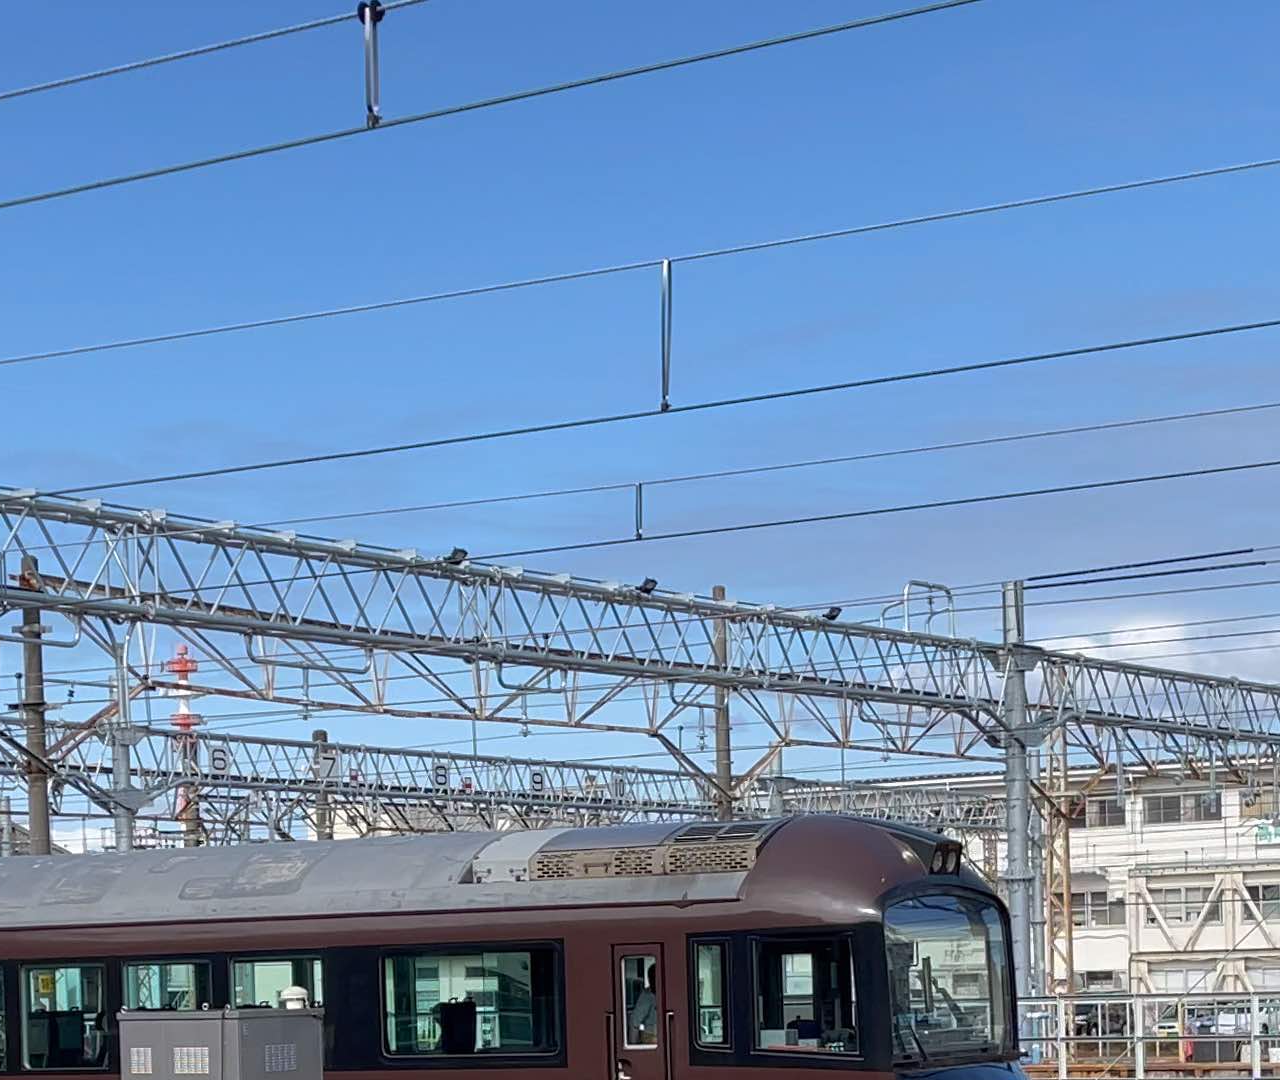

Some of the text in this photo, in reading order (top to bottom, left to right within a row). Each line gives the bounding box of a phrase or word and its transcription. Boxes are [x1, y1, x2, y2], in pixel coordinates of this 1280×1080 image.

[212, 748, 227, 771] 6
[322, 757, 336, 778] 7
[435, 765, 448, 786] 8
[531, 772, 544, 792] 9
